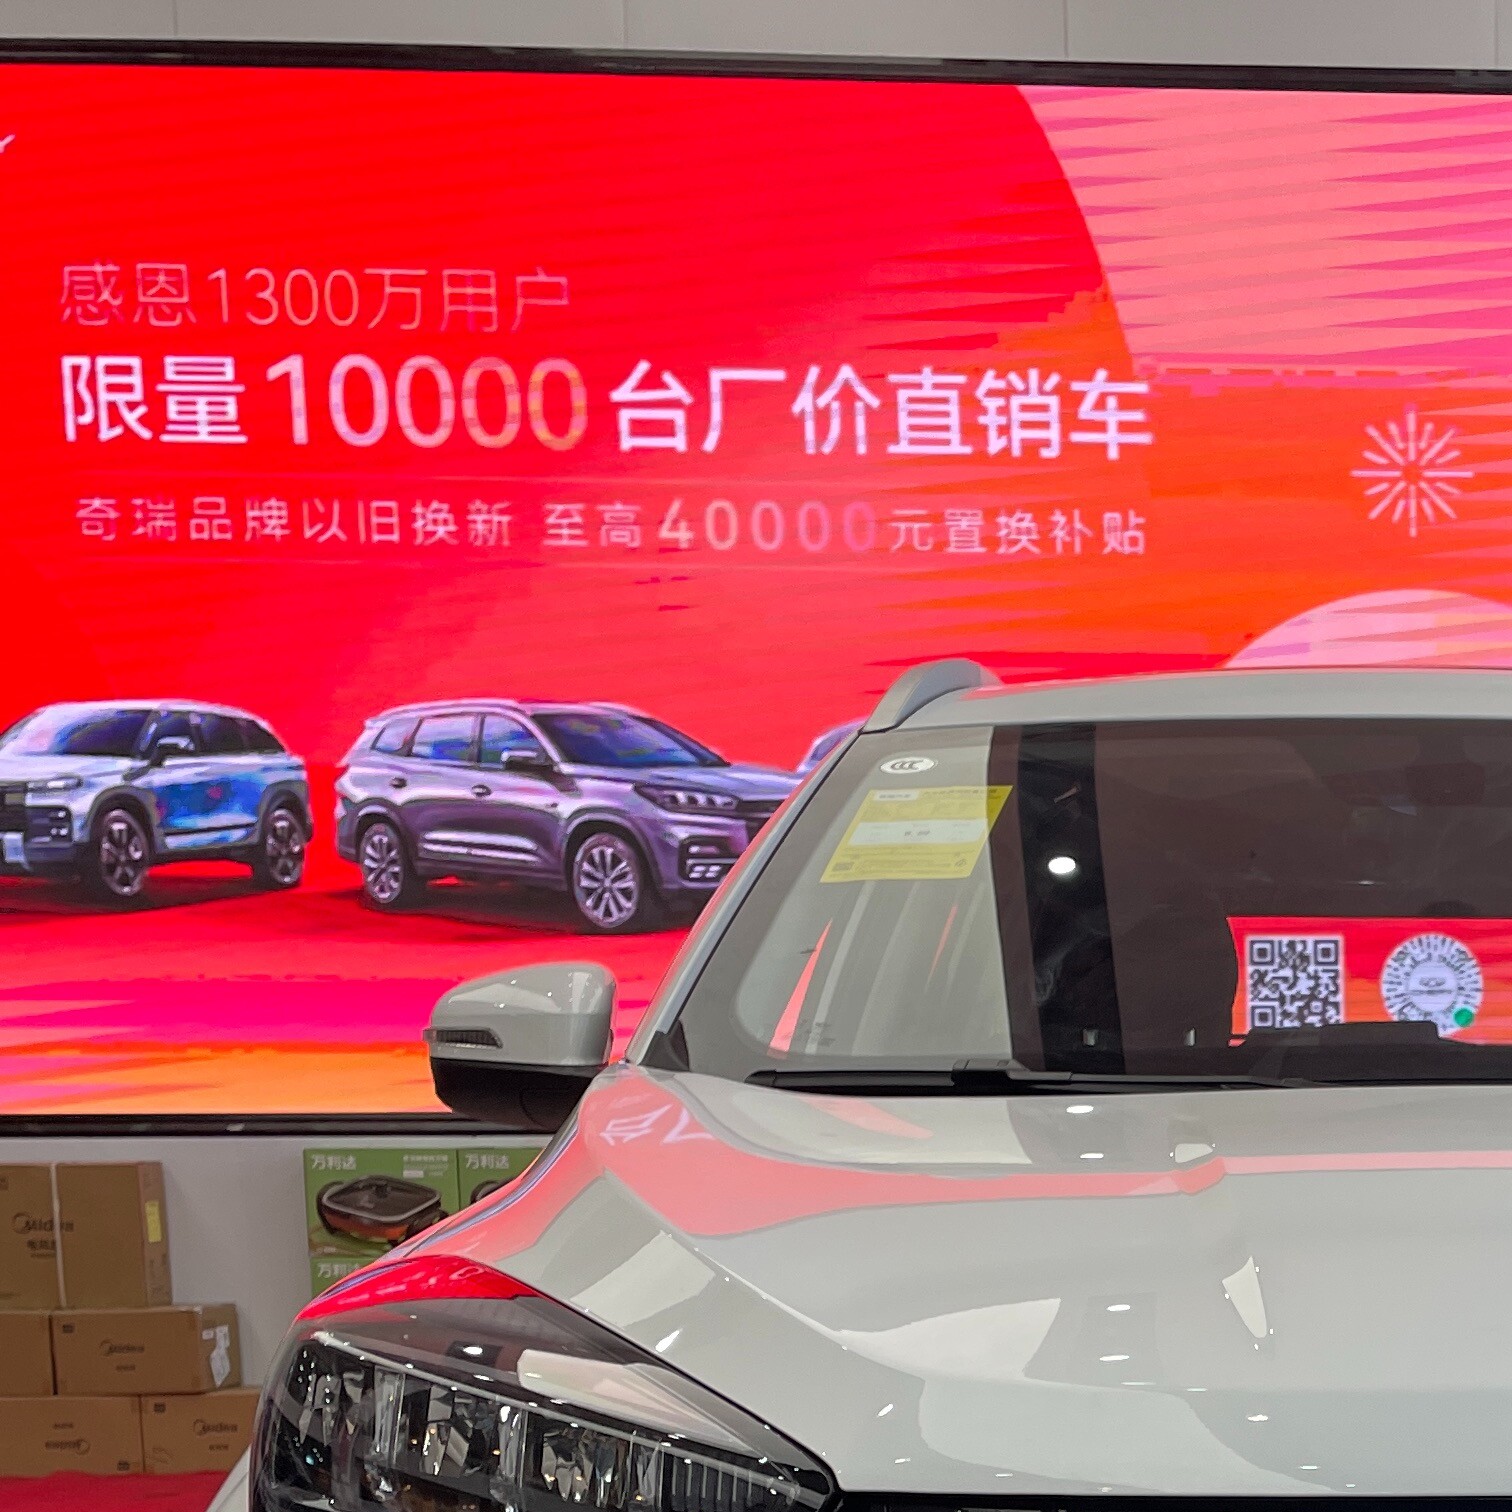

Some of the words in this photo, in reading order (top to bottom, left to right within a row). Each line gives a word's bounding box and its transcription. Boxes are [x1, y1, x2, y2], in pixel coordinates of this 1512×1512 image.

[60, 260, 571, 333] 感恩1300万用户
[75, 496, 513, 547] 奇瑞品牌以旧换新
[542, 498, 1146, 555] 至高40000元置换补贴
[311, 1154, 357, 1171] 万利达
[465, 1153, 510, 1170] 万利达
